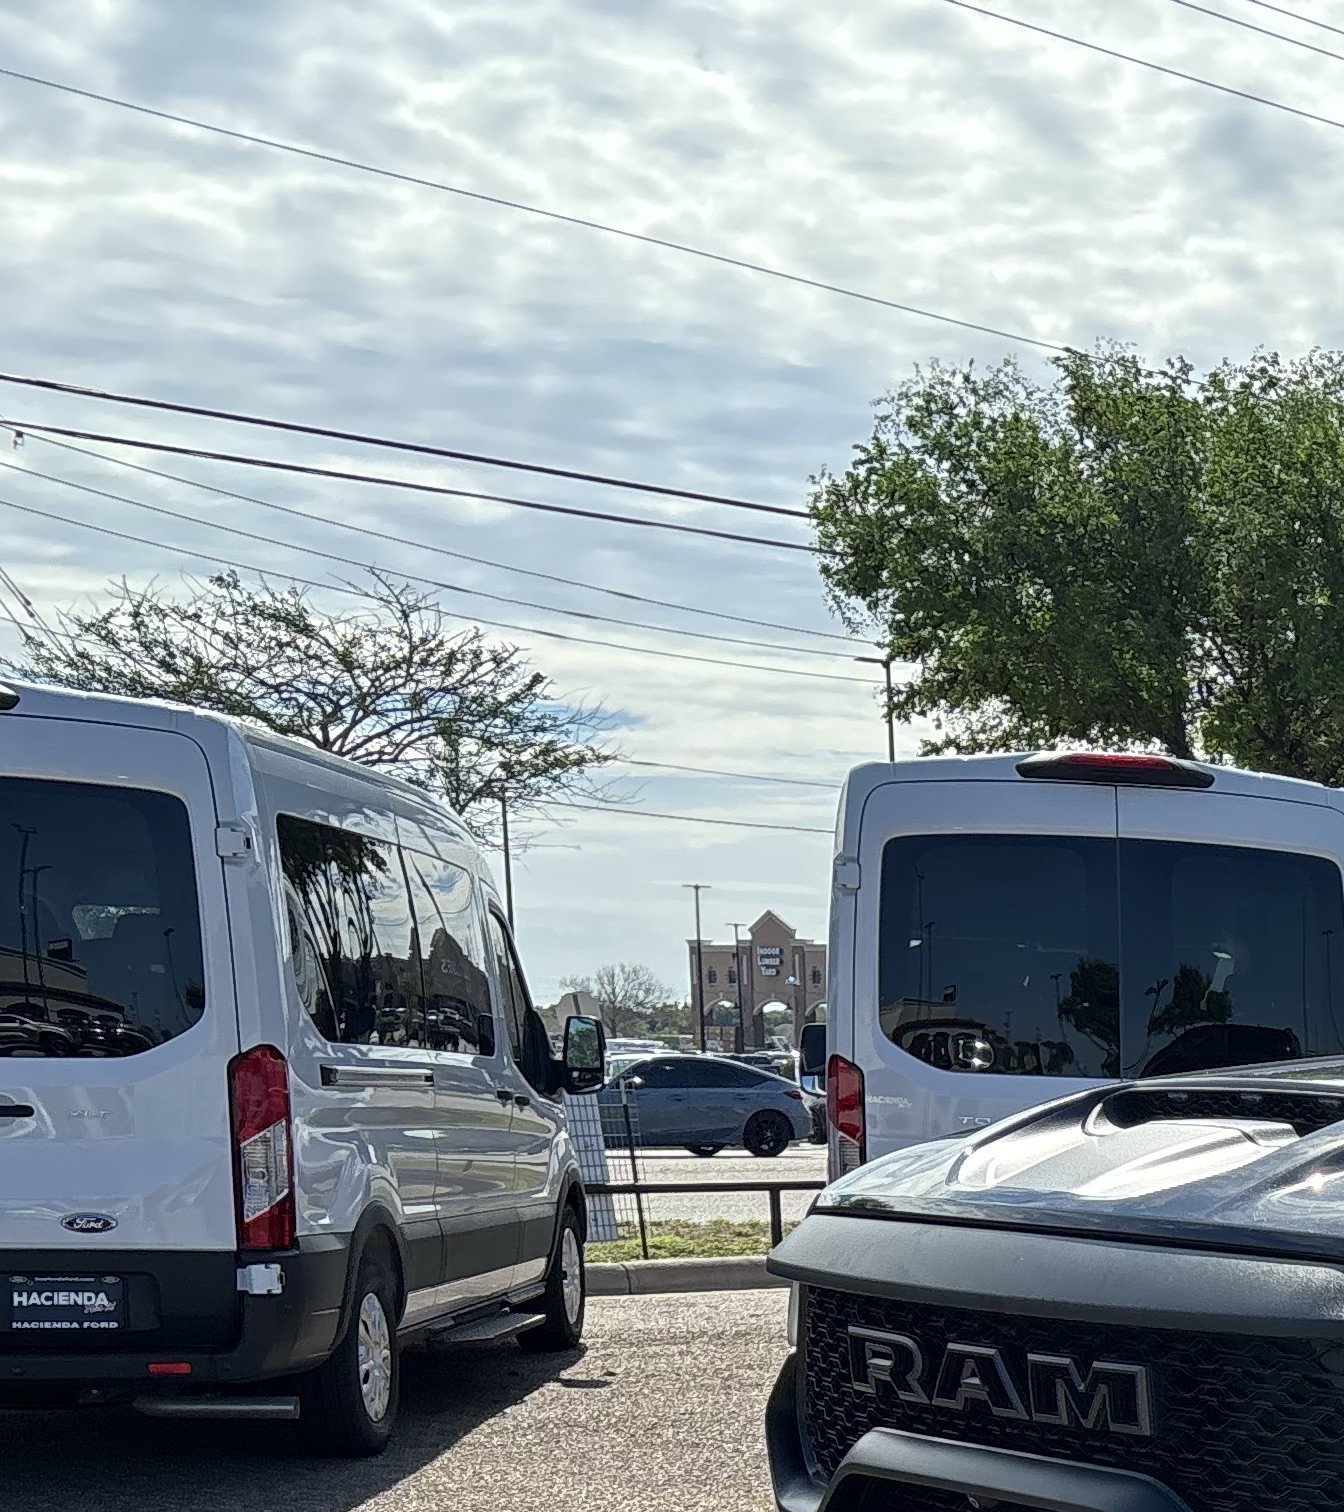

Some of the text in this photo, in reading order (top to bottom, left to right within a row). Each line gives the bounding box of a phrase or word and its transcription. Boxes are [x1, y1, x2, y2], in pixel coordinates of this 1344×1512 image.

[12, 1291, 109, 1307] HACIENDA
[11, 1321, 119, 1329] HACIENDA FORD
[848, 1325, 1152, 1436] RAM
